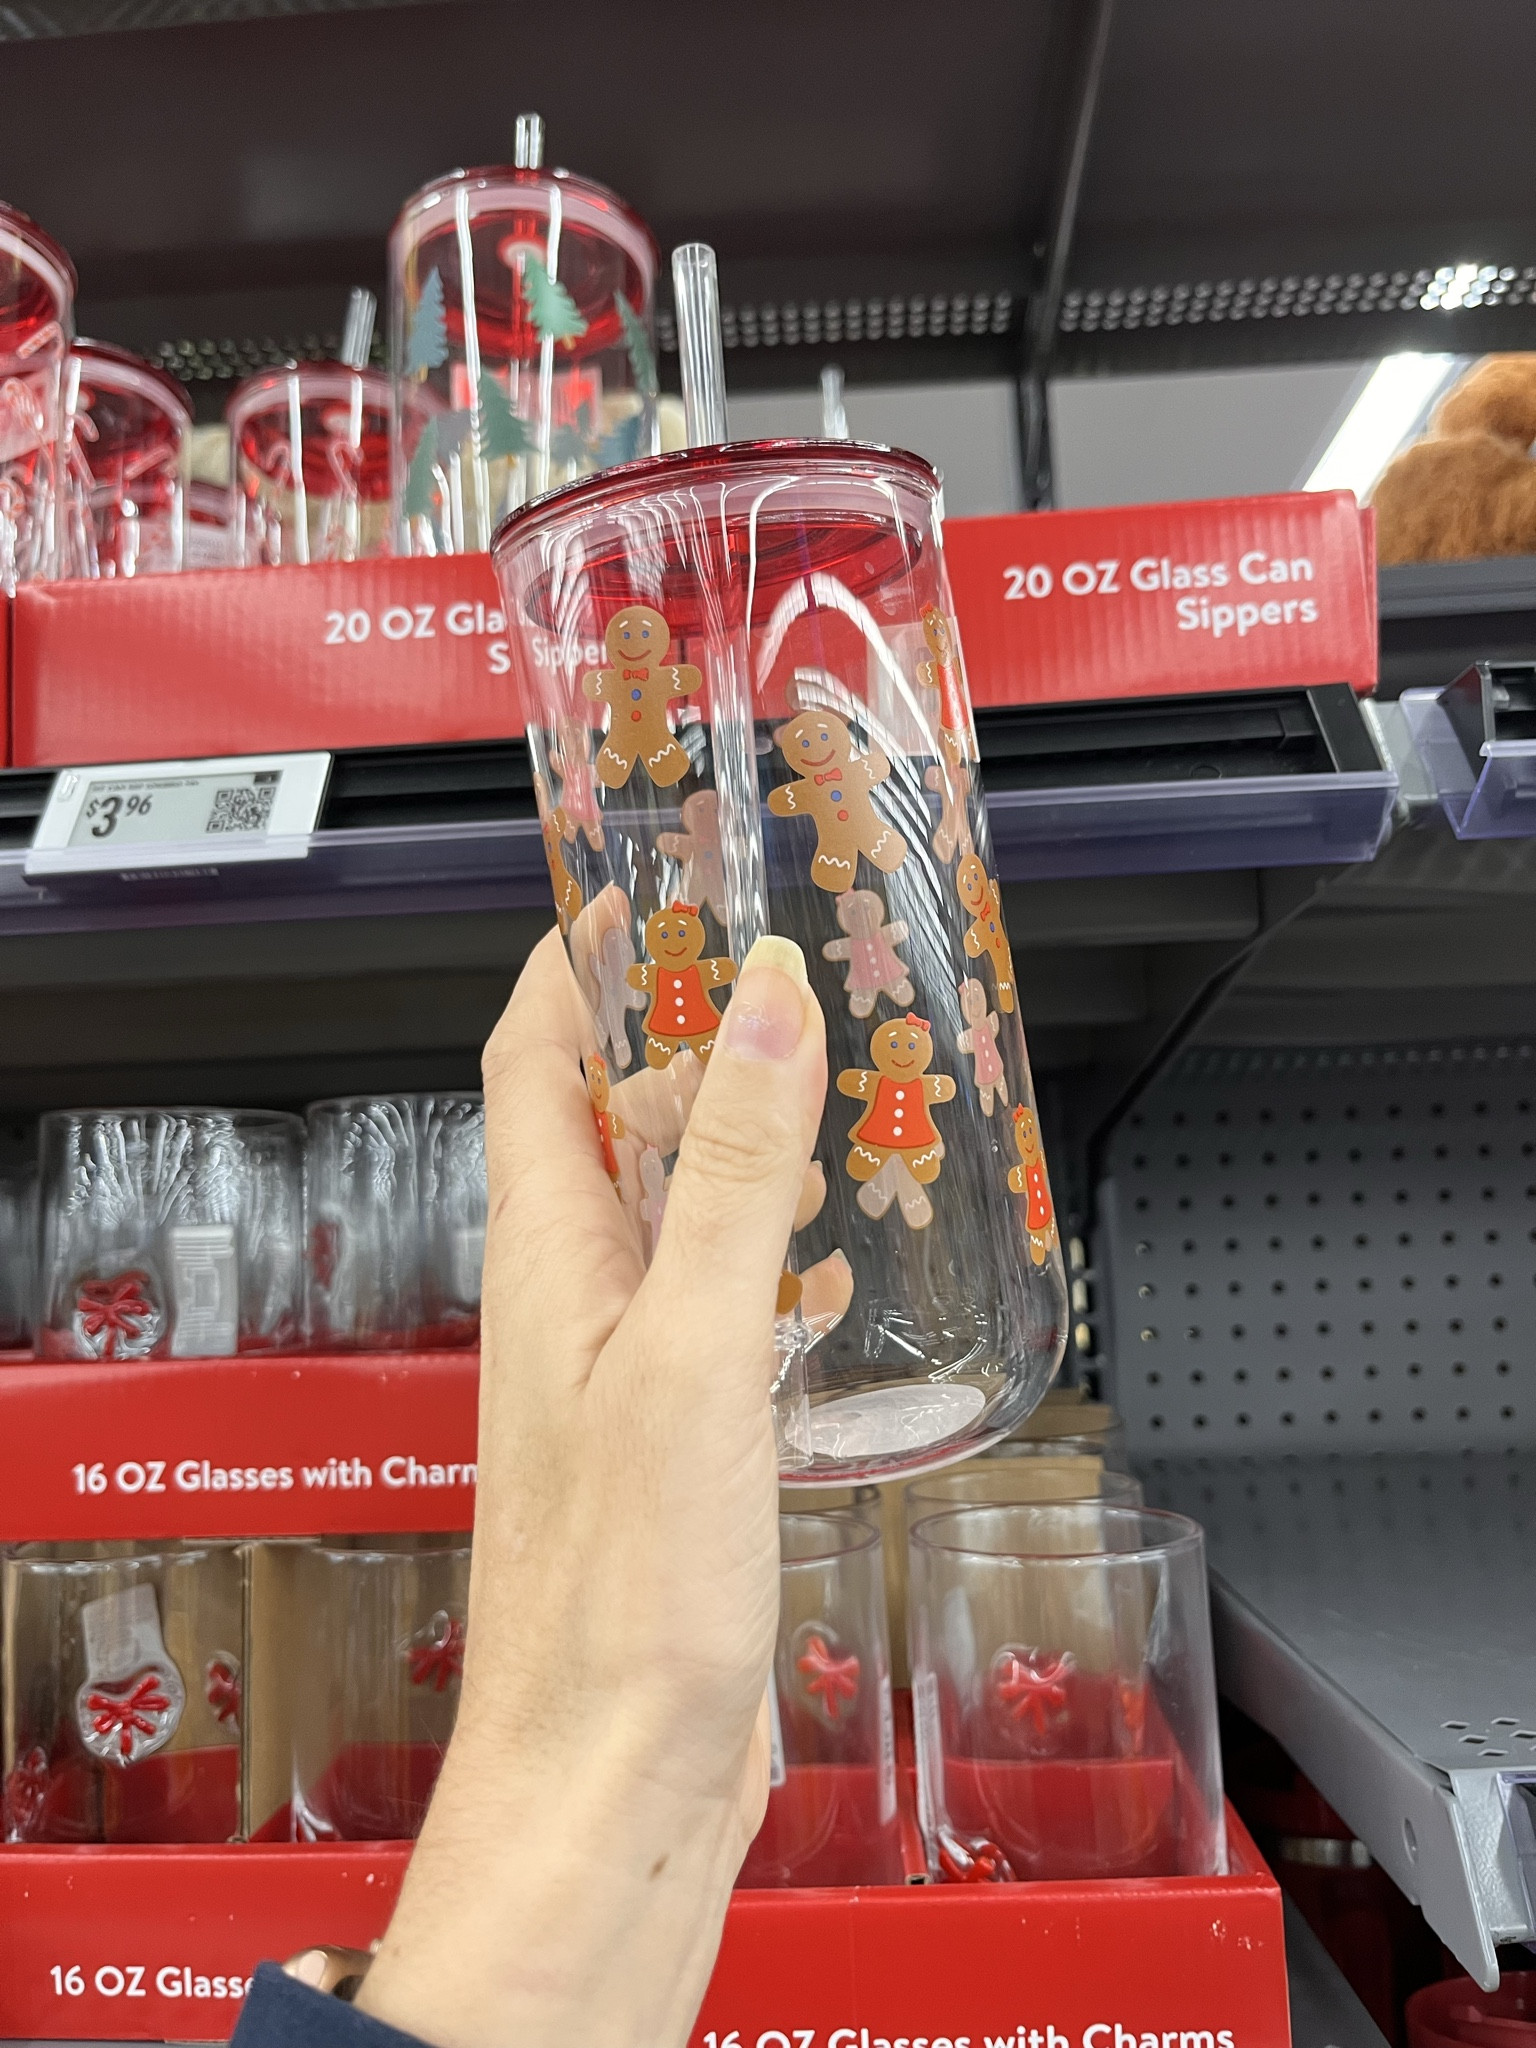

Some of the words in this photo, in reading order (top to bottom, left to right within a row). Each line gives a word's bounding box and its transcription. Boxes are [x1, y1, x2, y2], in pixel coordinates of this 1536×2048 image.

[1003, 564, 1053, 600] 20
[1062, 558, 1121, 596] OZ
[1129, 556, 1228, 591] Glass
[1238, 550, 1314, 583] Can
[324, 609, 371, 645] 20
[380, 605, 436, 640] OZ
[1175, 596, 1318, 637] Sippers
[73, 1463, 108, 1495] 16
[115, 1459, 167, 1494] OZ
[174, 1459, 294, 1492] Glasses
[302, 1456, 373, 1489] with
[50, 1965, 85, 1997] 16
[94, 1965, 147, 1998] OZ
[1082, 2023, 1236, 2048] Charms
